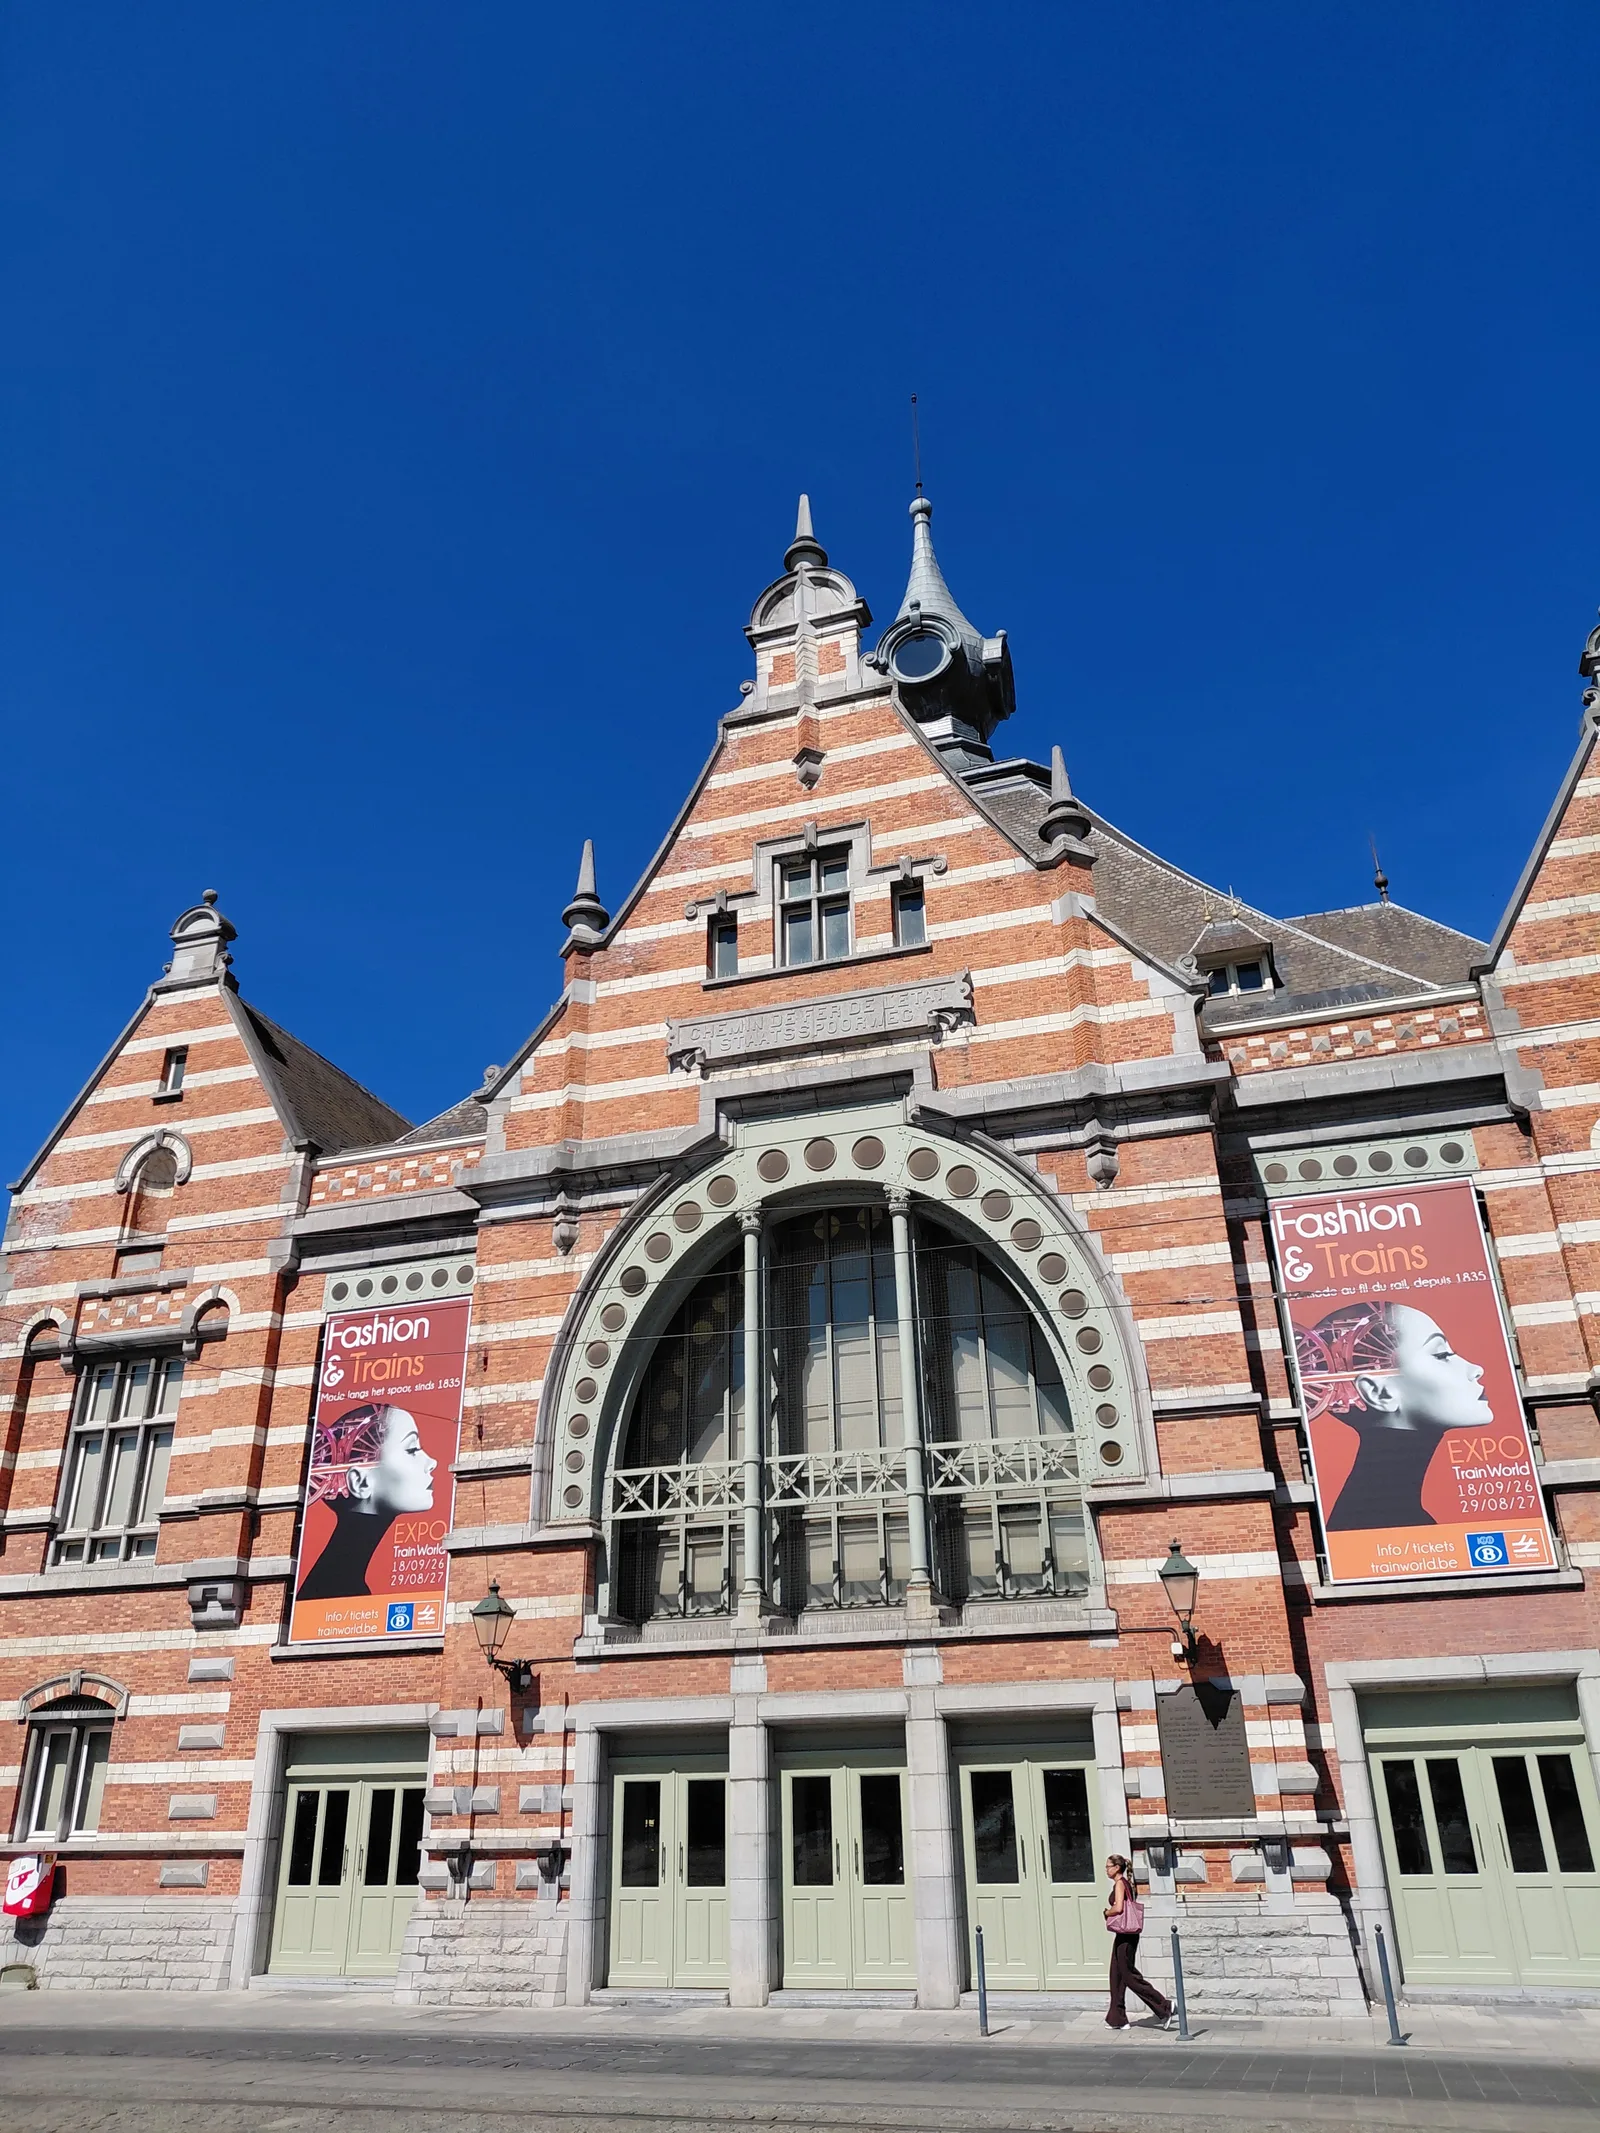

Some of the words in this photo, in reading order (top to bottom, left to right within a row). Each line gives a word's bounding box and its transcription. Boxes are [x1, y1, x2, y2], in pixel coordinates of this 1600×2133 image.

[690, 1016, 764, 1041] CHEMIN
[770, 1009, 796, 1029] DE
[803, 1004, 841, 1024] FER
[849, 998, 875, 1016] DE
[1275, 1199, 1422, 1241] Fashion
[1284, 1245, 1313, 1283] &
[1315, 1242, 1428, 1279] Trains
[1341, 1286, 1356, 1296] au
[1359, 1283, 1369, 1294] fil
[1372, 1281, 1387, 1292] du
[1413, 1275, 1452, 1289] depuis
[1455, 1270, 1487, 1283] 1835
[327, 1313, 430, 1351] Fashion
[323, 1354, 345, 1387] &
[350, 1352, 425, 1384] Trains
[320, 1391, 346, 1403] Mode
[347, 1389, 369, 1400] langs
[371, 1386, 385, 1397] het
[414, 1380, 435, 1391] sinds
[437, 1377, 461, 1390] 1835
[1447, 1435, 1525, 1464] EXPO
[1452, 1465, 1487, 1480] Train
[1486, 1461, 1531, 1477] World
[1457, 1479, 1534, 1497] 18/09/26
[1460, 1495, 1536, 1513] 29/08/27
[393, 1520, 448, 1544] EXPO
[393, 1544, 416, 1558] Train
[1376, 1543, 1402, 1557] Info
[1404, 1542, 1410, 1554] /
[1412, 1540, 1455, 1554] tickets
[1481, 1547, 1496, 1561] B
[391, 1558, 445, 1573] 18/09/26
[1371, 1558, 1459, 1574] trainworld.be
[390, 1571, 444, 1586] 29/08/27
[325, 1611, 342, 1622] Info
[343, 1610, 349, 1621] /
[350, 1609, 379, 1620] tickets
[317, 1623, 378, 1637] trainworld.be
